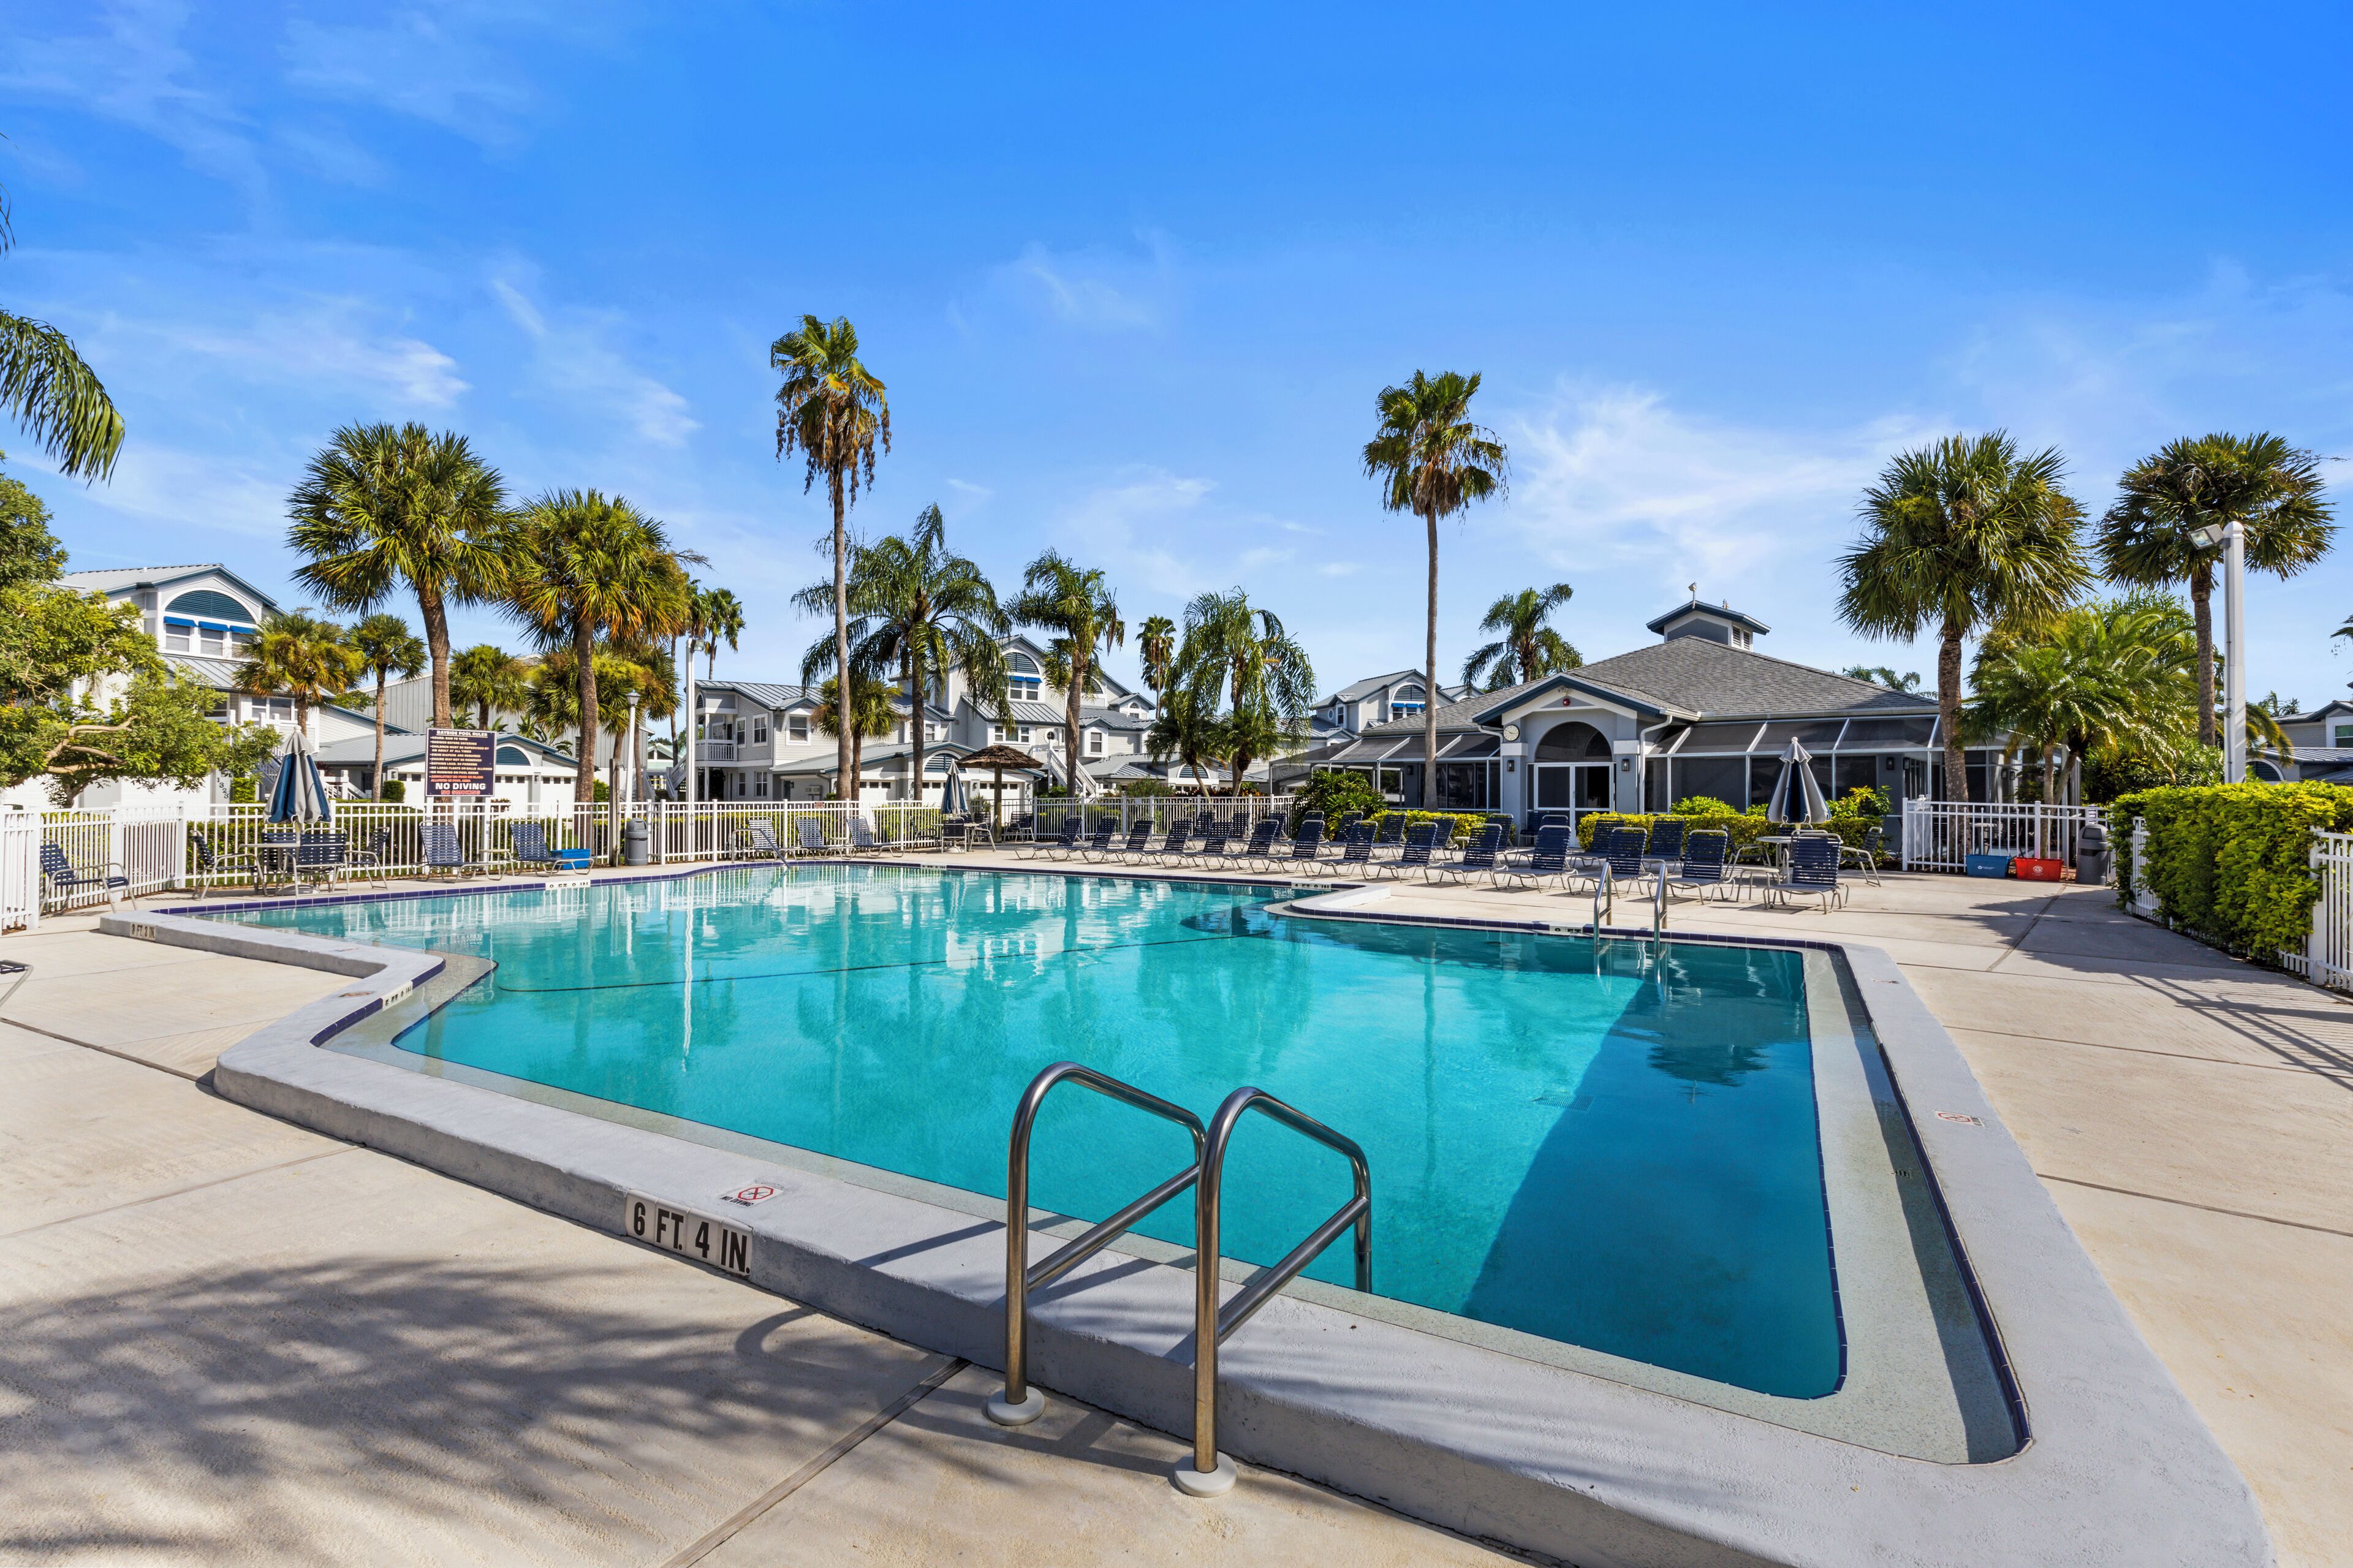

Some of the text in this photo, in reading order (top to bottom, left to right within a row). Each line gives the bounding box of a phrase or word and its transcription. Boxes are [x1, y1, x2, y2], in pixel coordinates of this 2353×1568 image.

[730, 1198, 754, 1207] DIVING
[634, 1202, 750, 1274] 6 FT. 4 IN.
